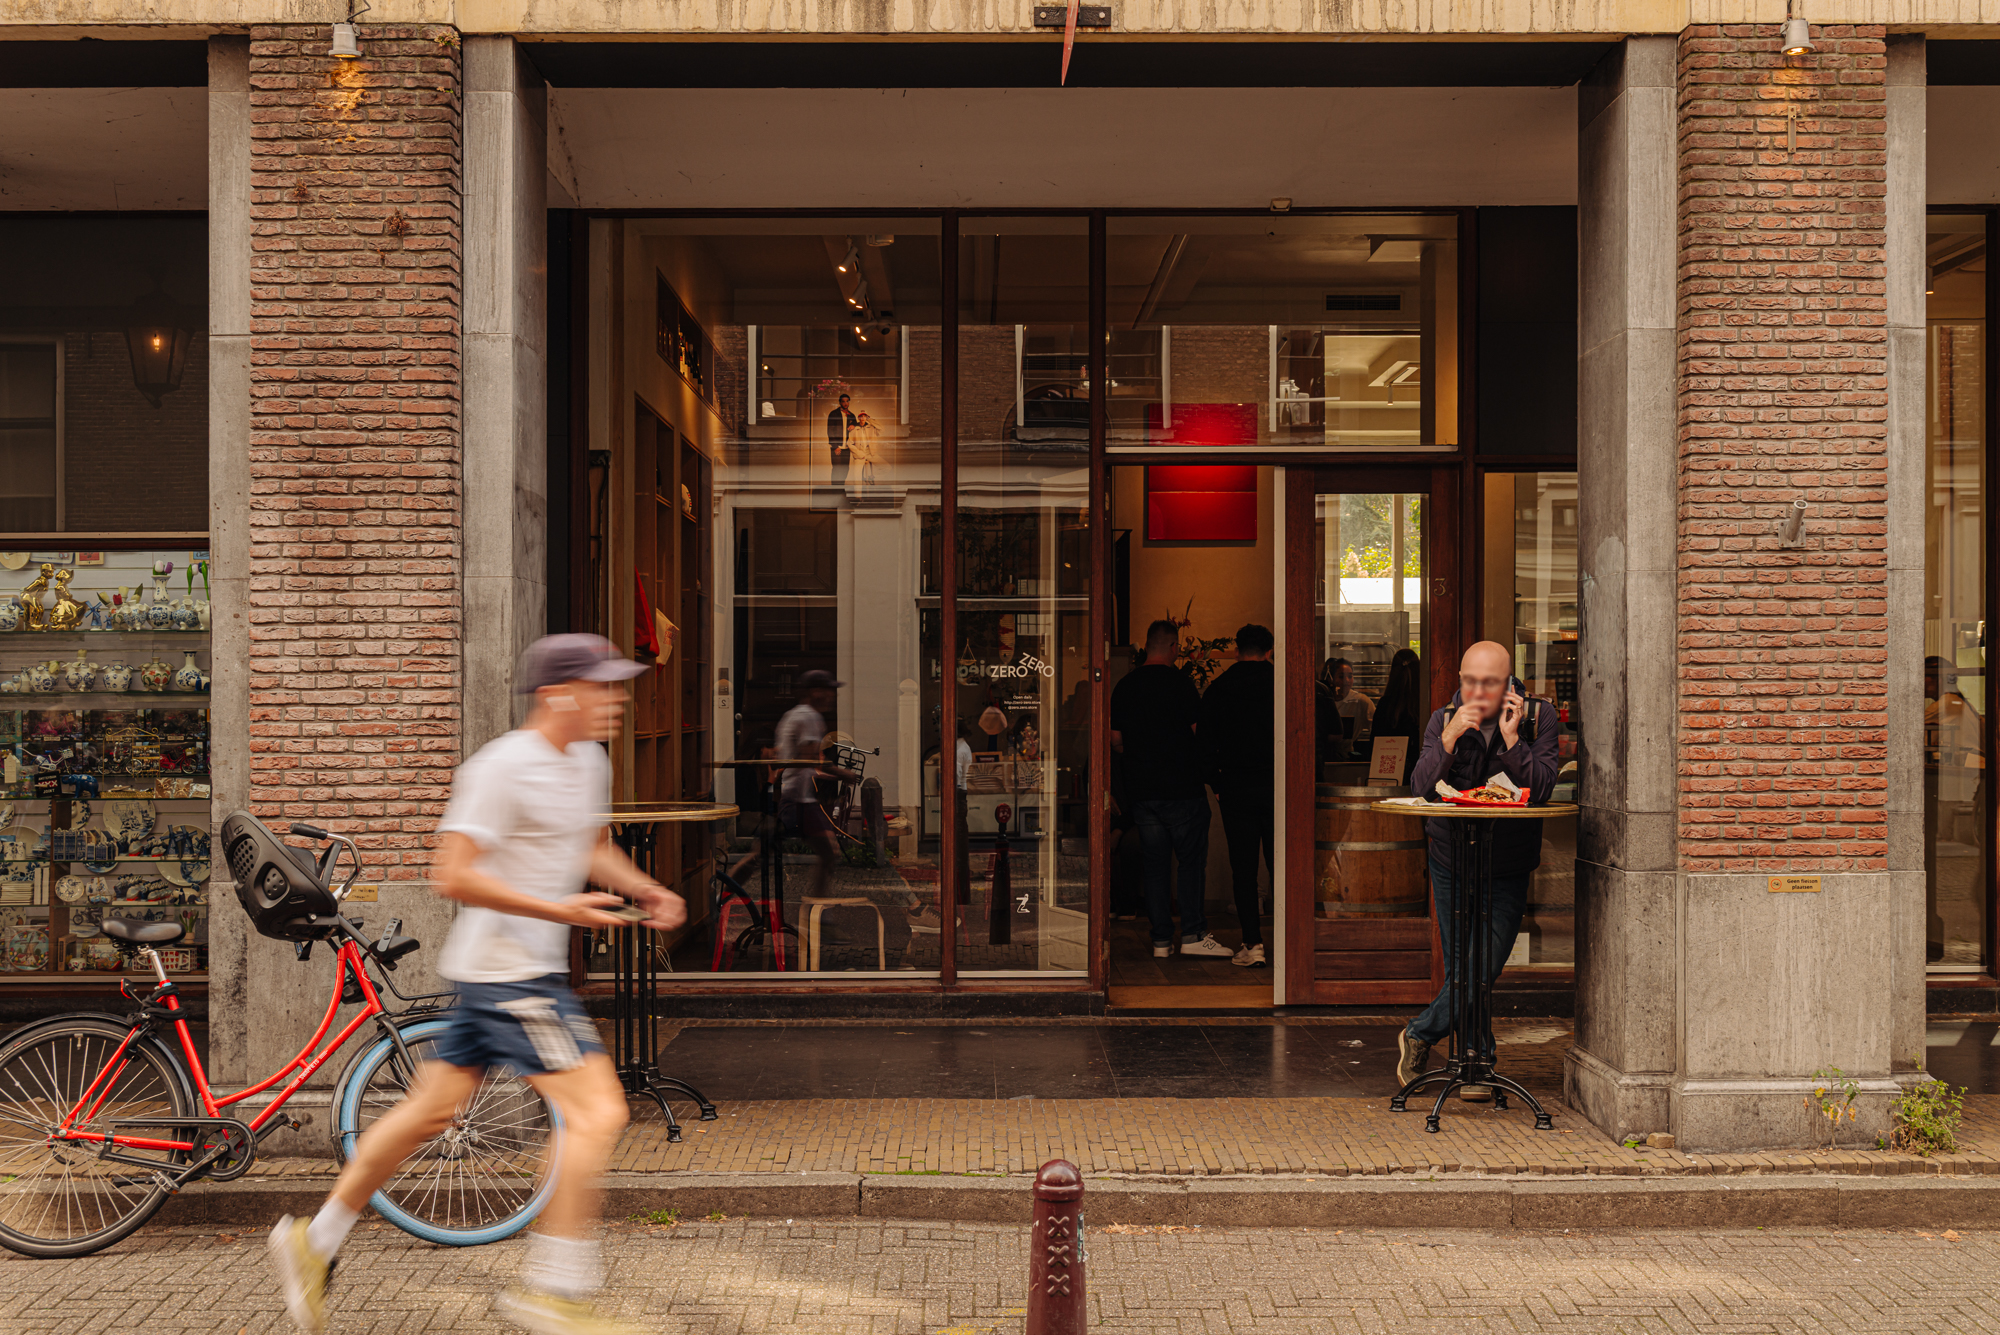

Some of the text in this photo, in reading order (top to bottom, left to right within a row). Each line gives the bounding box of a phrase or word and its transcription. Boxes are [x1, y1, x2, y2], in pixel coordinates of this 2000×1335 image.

[1433, 577, 1446, 597] 3
[990, 666, 1029, 678] ZERO
[1018, 652, 1055, 678] ZERO
